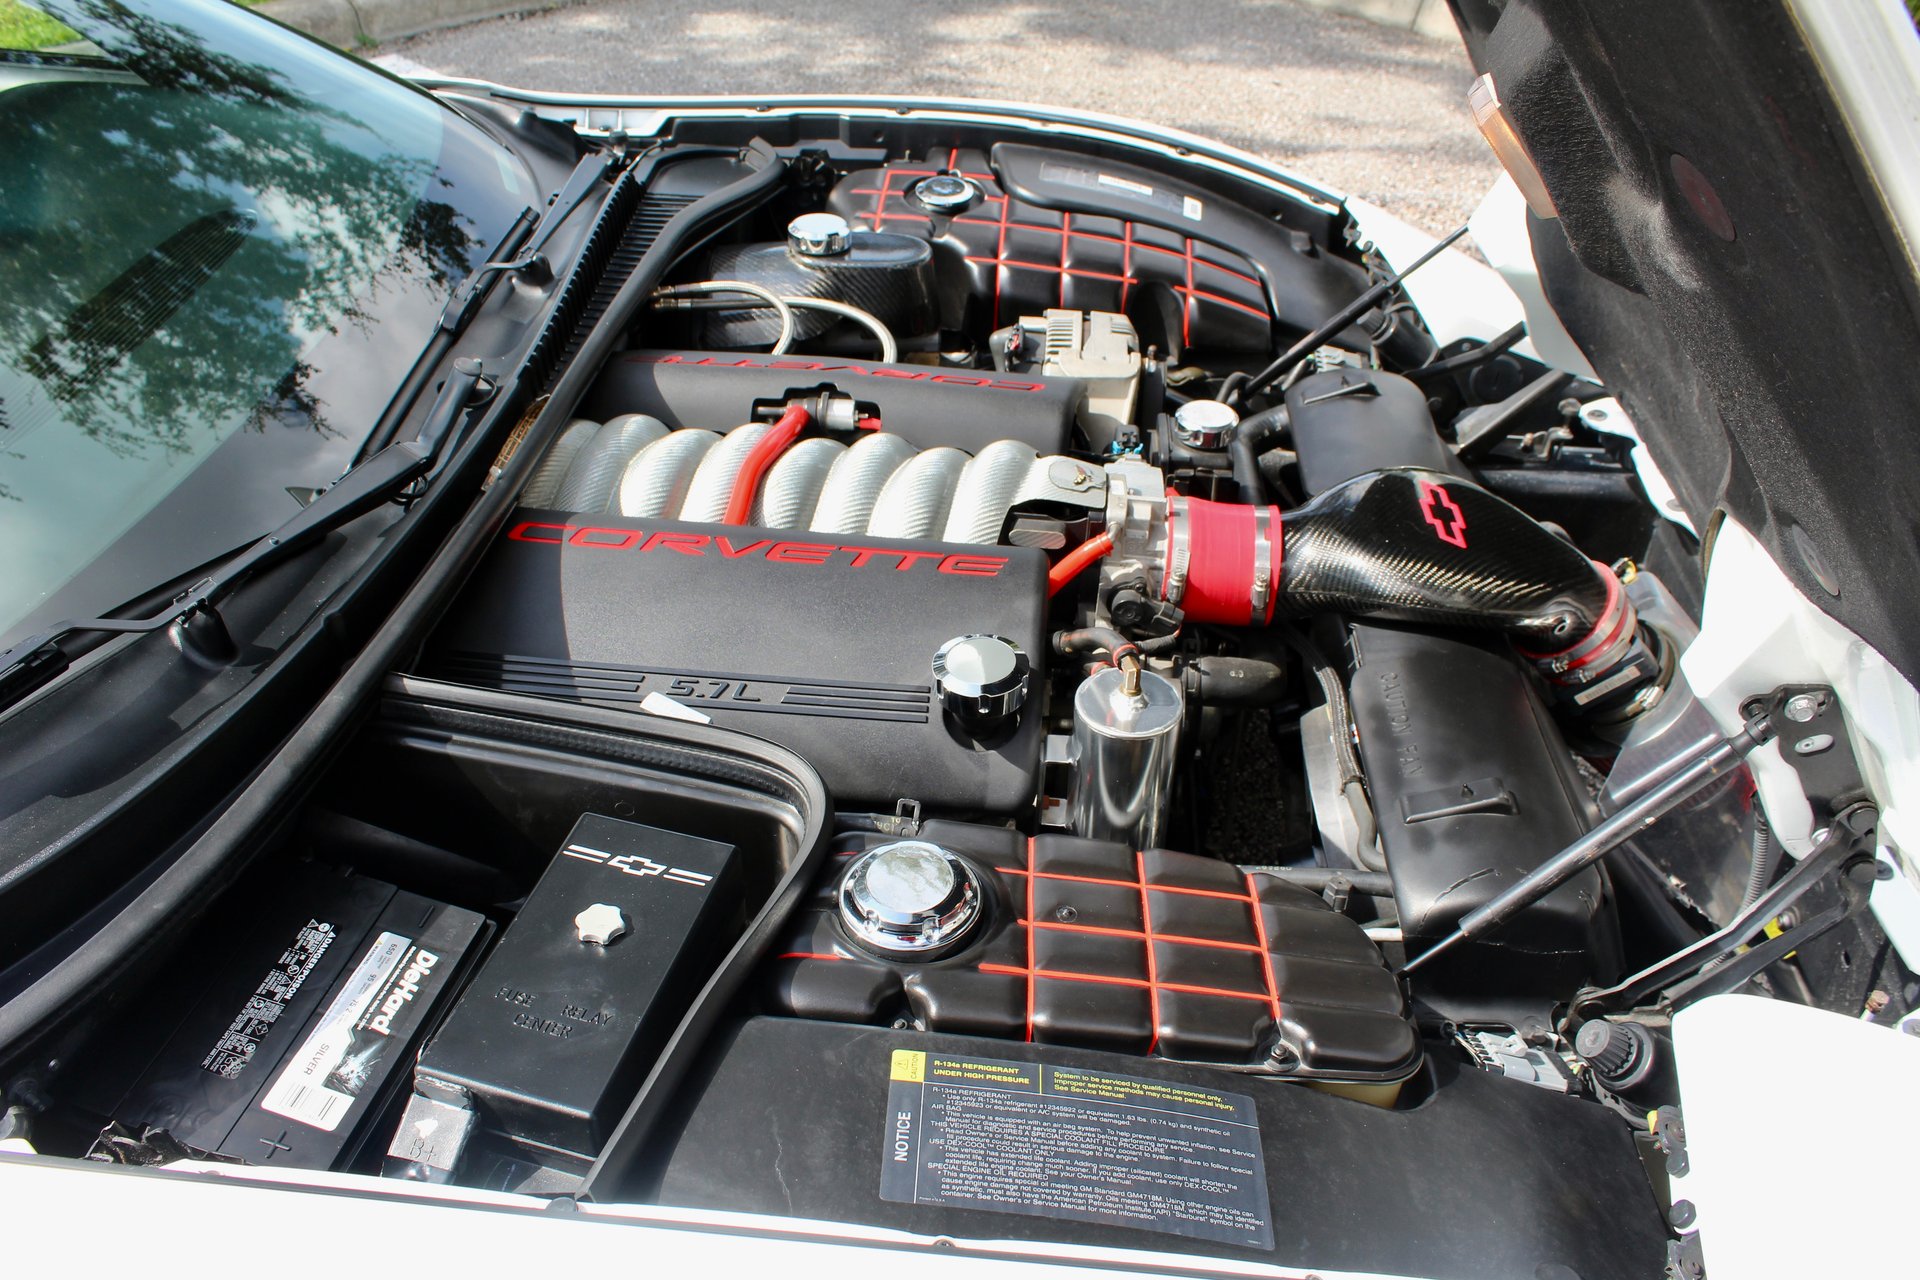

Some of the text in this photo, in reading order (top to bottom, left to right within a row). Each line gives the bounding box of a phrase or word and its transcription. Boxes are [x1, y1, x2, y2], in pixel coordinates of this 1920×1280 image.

[507, 522, 1010, 577] CORVETTE
[665, 678, 761, 701] 5.7L
[1380, 672, 1424, 778] CAUTION FAN
[386, 943, 398, 956] 650
[284, 937, 333, 1000] DANGER/POISON
[370, 949, 439, 1036] DieHard
[495, 986, 614, 1026] FUSE RELAY
[513, 1012, 573, 1039] CENTER
[304, 1043, 330, 1075] SILVER
[911, 1053, 919, 1079] CAUTION
[962, 1063, 1018, 1073] REFRIGERANT
[986, 1074, 1029, 1083] PRESSURE
[1054, 1071, 1080, 1080] System
[1101, 1077, 1130, 1086] serviced
[1142, 1083, 1170, 1094] qualified
[1172, 1088, 1205, 1100] personnel
[1054, 1077, 1085, 1087] Improper
[1087, 1081, 1112, 1090] service
[1114, 1085, 1143, 1094] methods
[1184, 1096, 1213, 1108] personal
[1070, 1085, 1096, 1094] Service
[958, 1089, 1011, 1099] REFRIGERANT
[994, 1104, 1027, 1113] equivalent
[1052, 1110, 1075, 1119] system
[1004, 1100, 1037, 1108] refrigerant
[1086, 1109, 1119, 1119] equivalent
[1193, 1126, 1221, 1136] synthetic
[894, 1111, 912, 1162] NOTICE
[984, 1126, 1022, 1135] REQUIRES
[1031, 1131, 1061, 1139] SPECIAL
[1064, 1135, 1098, 1144] COOLANT
[1118, 1142, 1164, 1154] PROCEDURE
[996, 1145, 1031, 1153] COOLANT
[1080, 1143, 1102, 1152] adding
[1178, 1158, 1201, 1166] Failure
[1230, 1166, 1252, 1176] special
[1008, 1171, 1048, 1181] REQUIRED
[964, 1179, 987, 1187] engine
[990, 1182, 1018, 1190] damage
[1120, 1197, 1147, 1207] meeting
[1234, 1215, 1264, 1225] identified
[984, 1175, 1012, 1183] requires
[1014, 1178, 1038, 1186] special
[1050, 1182, 1077, 1191] meeting
[1094, 1187, 1124, 1196] Standard
[1166, 1198, 1184, 1206] Using
[1205, 1204, 1227, 1214] engine
[1060, 1202, 1086, 1210] Manual
[1053, 1195, 1086, 1204] American
[1088, 1199, 1123, 1209] Petroleum
[1125, 1204, 1151, 1213] Institute
[1209, 1217, 1233, 1227] symbol
